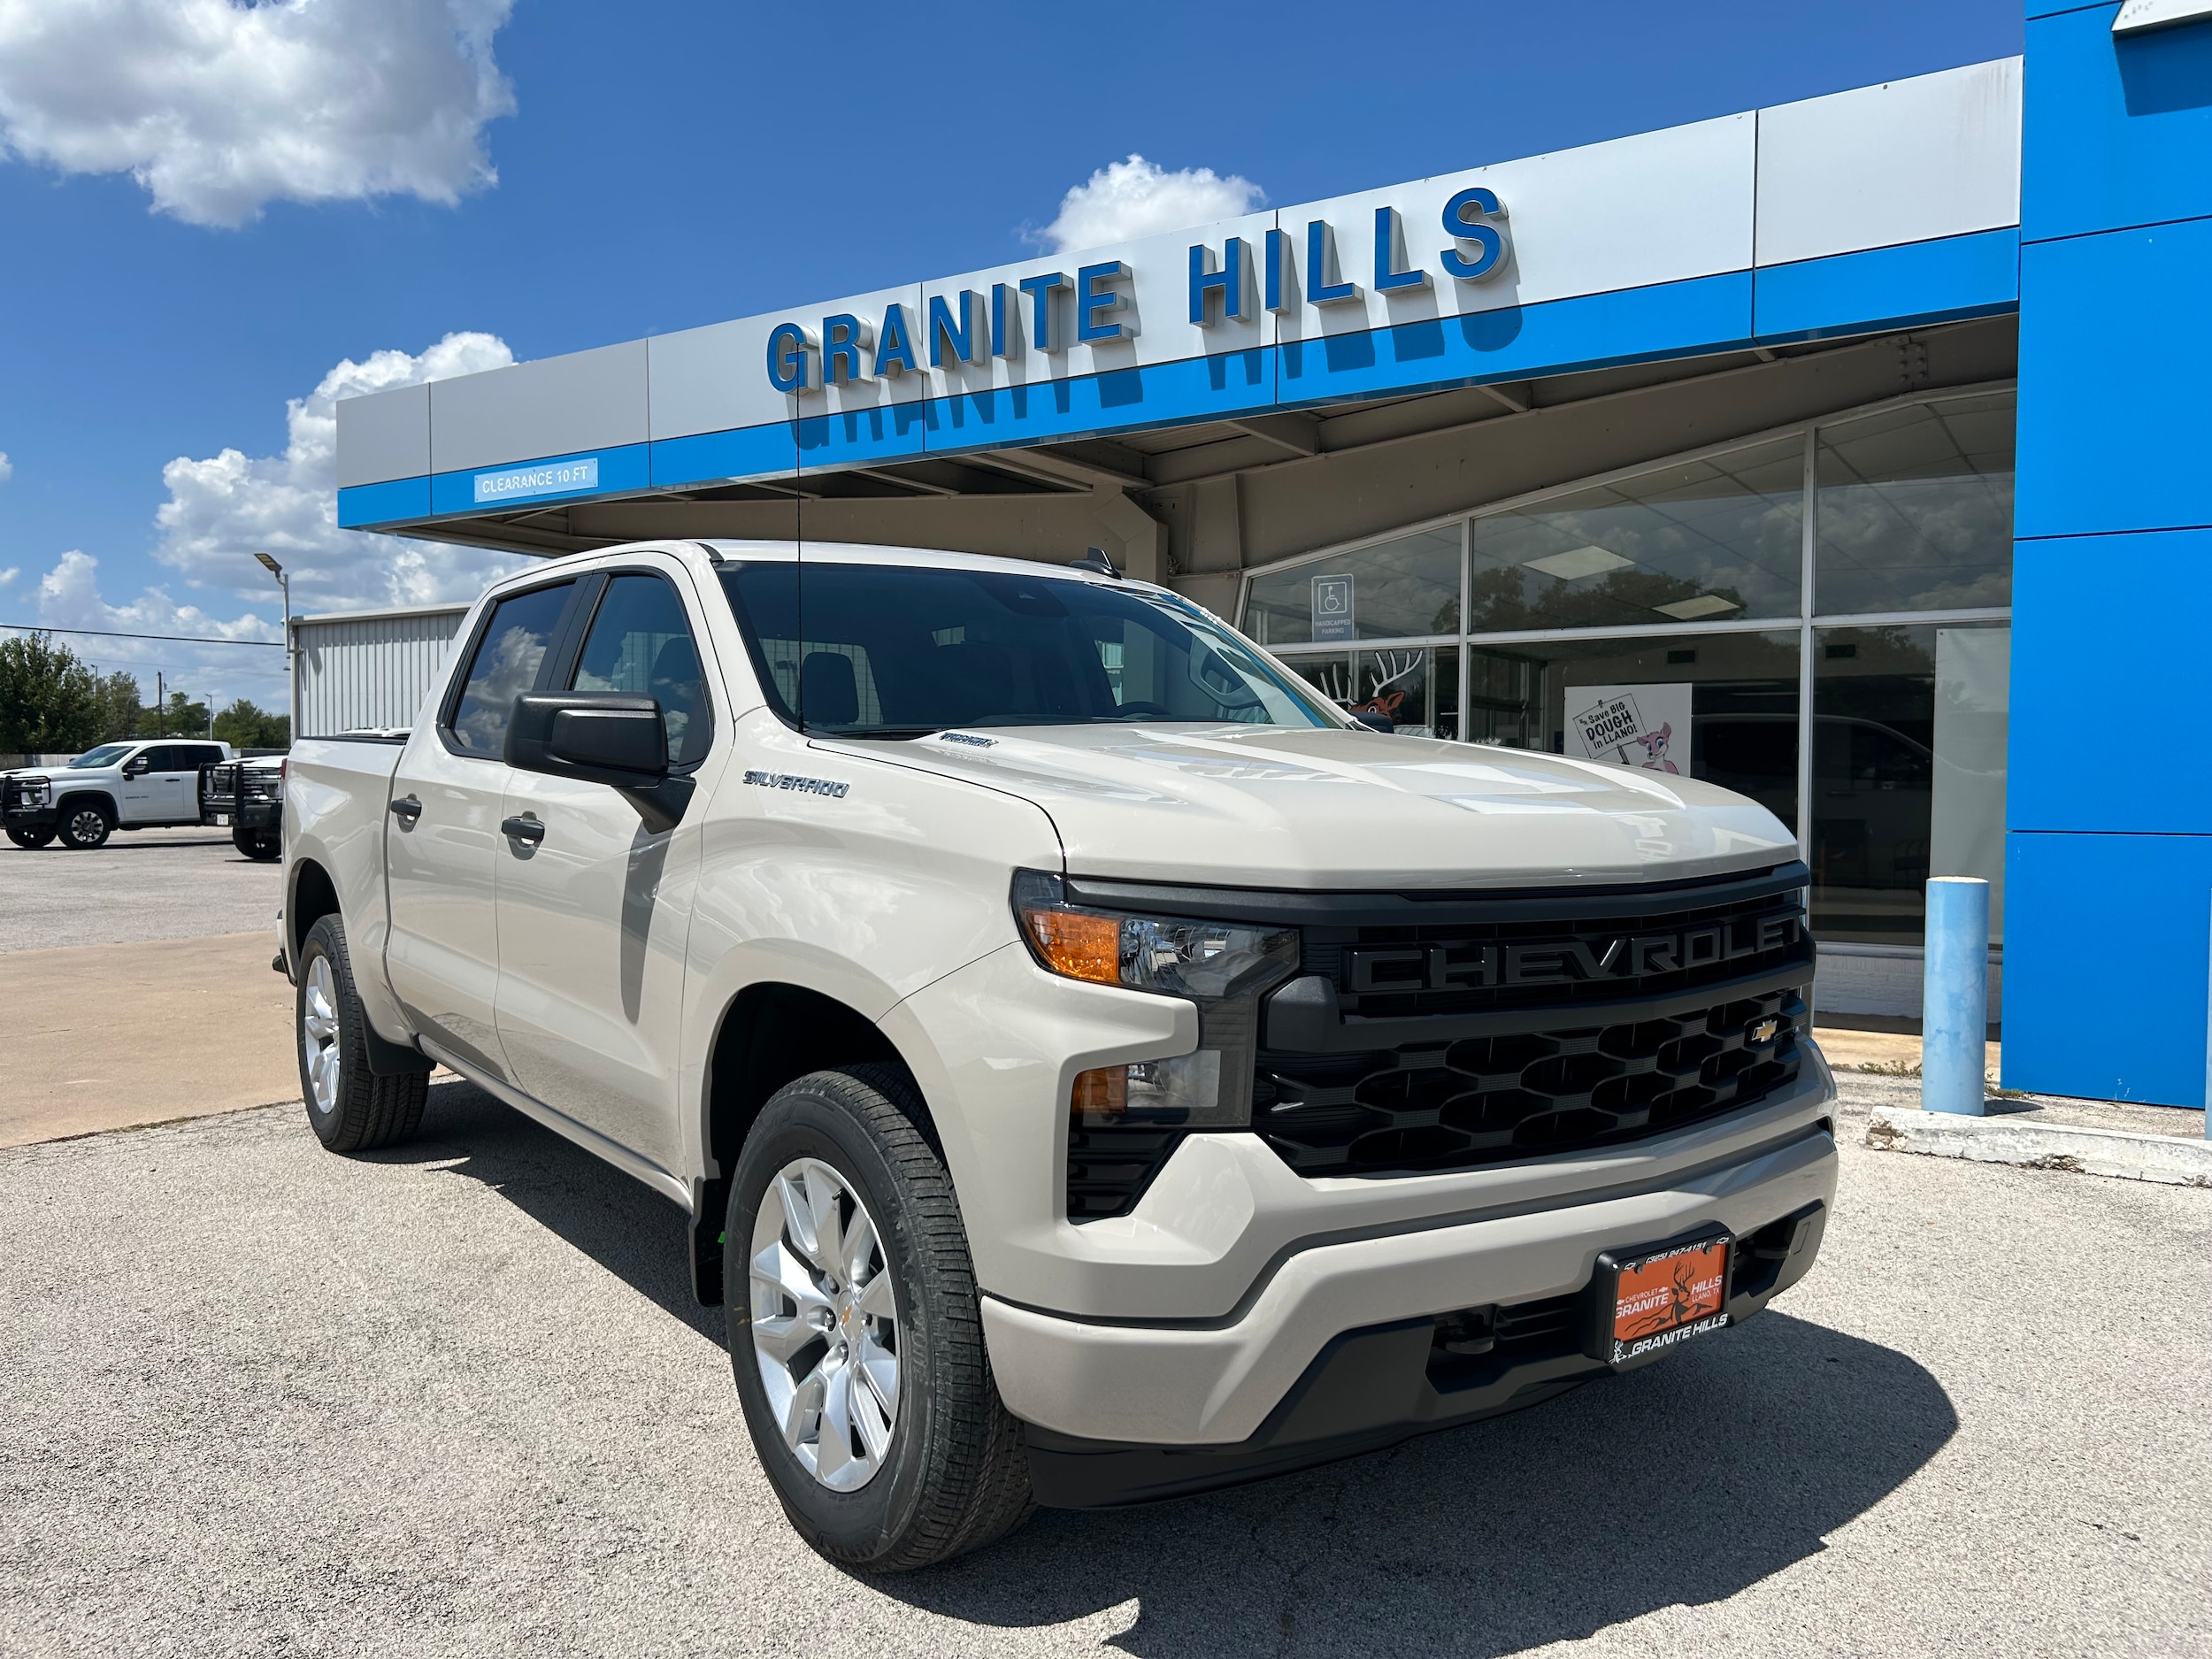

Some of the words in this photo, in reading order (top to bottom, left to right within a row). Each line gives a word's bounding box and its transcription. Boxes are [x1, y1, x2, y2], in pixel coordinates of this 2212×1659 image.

[767, 260, 1133, 395] GRANITE
[1188, 187, 1509, 328] HILLS
[482, 471, 553, 494] CLEARANCE
[557, 469, 570, 483] 10
[572, 465, 588, 481] FT
[1586, 710, 1633, 741] DOUGH
[1588, 711, 1609, 724] Save
[1609, 702, 1625, 714] BIG
[1603, 724, 1638, 744] LLANO!
[742, 770, 850, 798] SILVERADO
[1350, 916, 1800, 991] CHEVROLET
[1625, 1288, 1658, 1303] CHEVROLET
[1691, 1275, 1723, 1294] HILLS
[1616, 1293, 1670, 1319] GRANITE
[1631, 1325, 1692, 1356] GRANITE
[1693, 1313, 1728, 1335] HILLS
